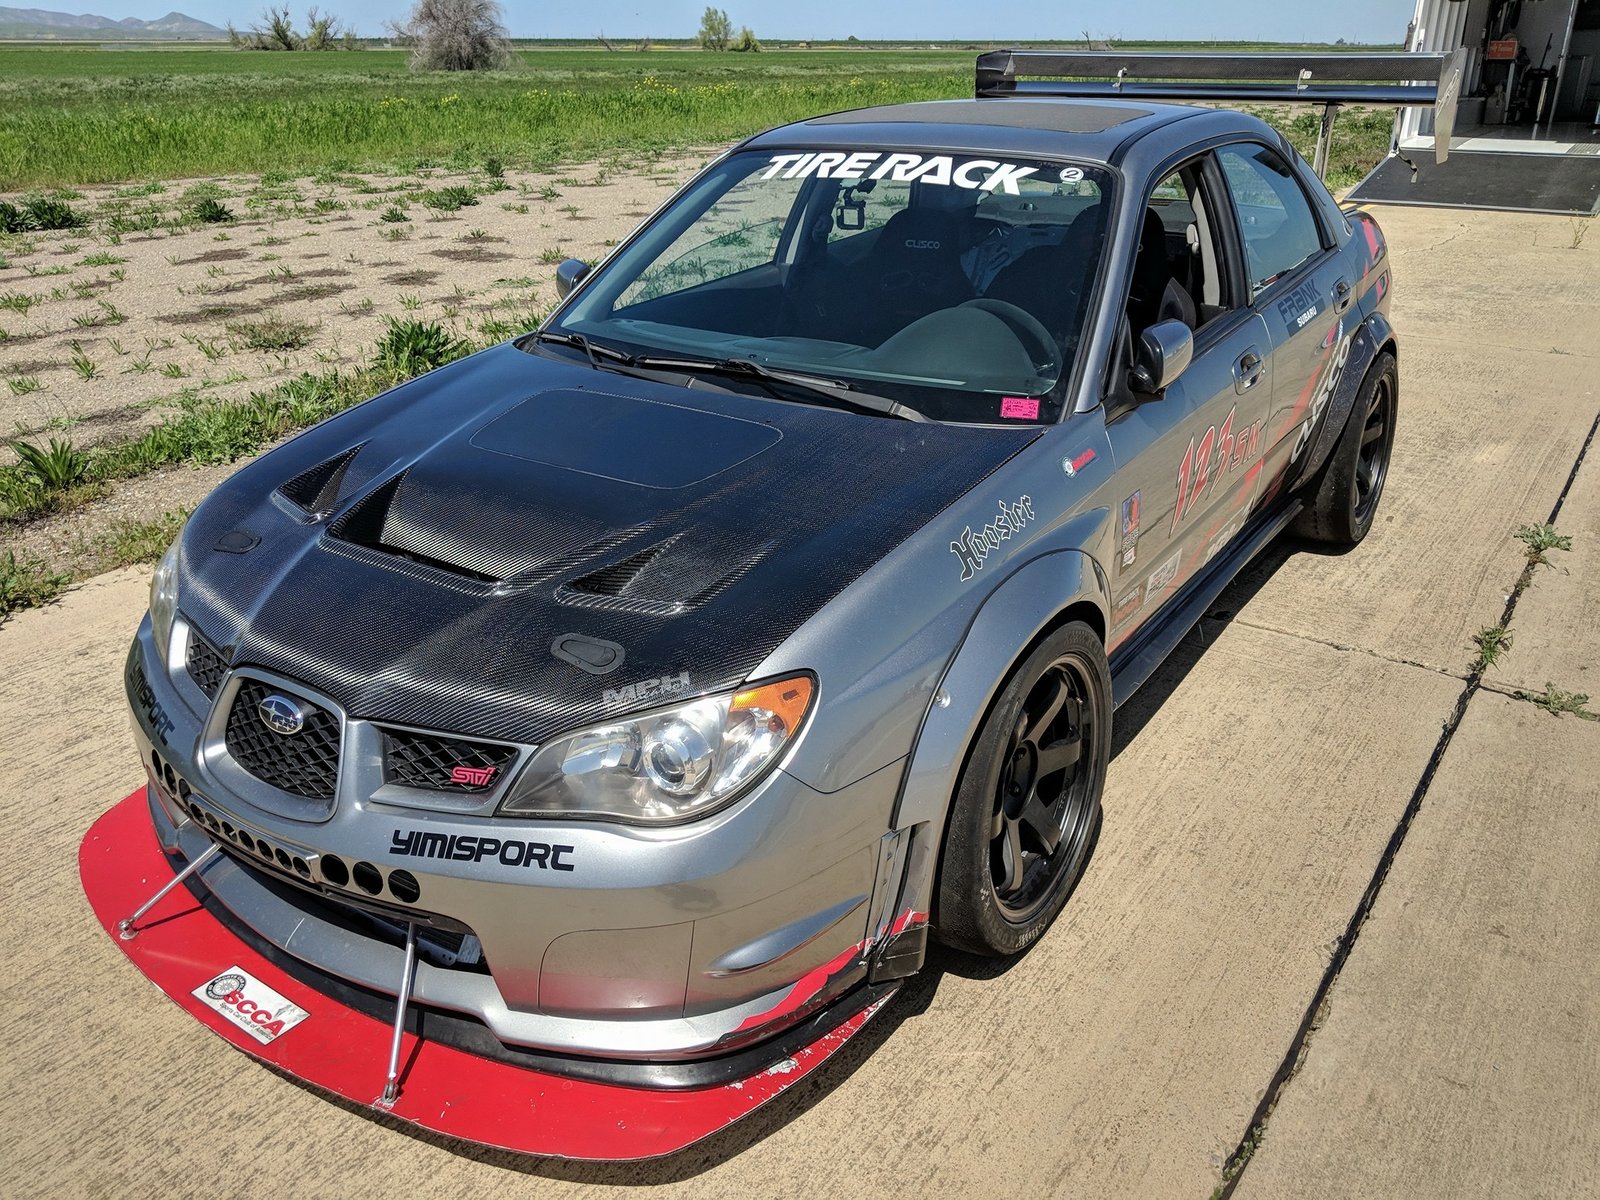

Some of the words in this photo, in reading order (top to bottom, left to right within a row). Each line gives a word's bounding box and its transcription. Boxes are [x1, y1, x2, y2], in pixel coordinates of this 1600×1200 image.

[905, 239, 941, 249] CUSCO
[1296, 305, 1318, 328] SUBARU
[949, 494, 1035, 582] Hoosier
[602, 671, 690, 704] MPH
[389, 829, 575, 872] YIMISPORT
[223, 990, 286, 1037] SCCA
[240, 1016, 251, 1026] Club
